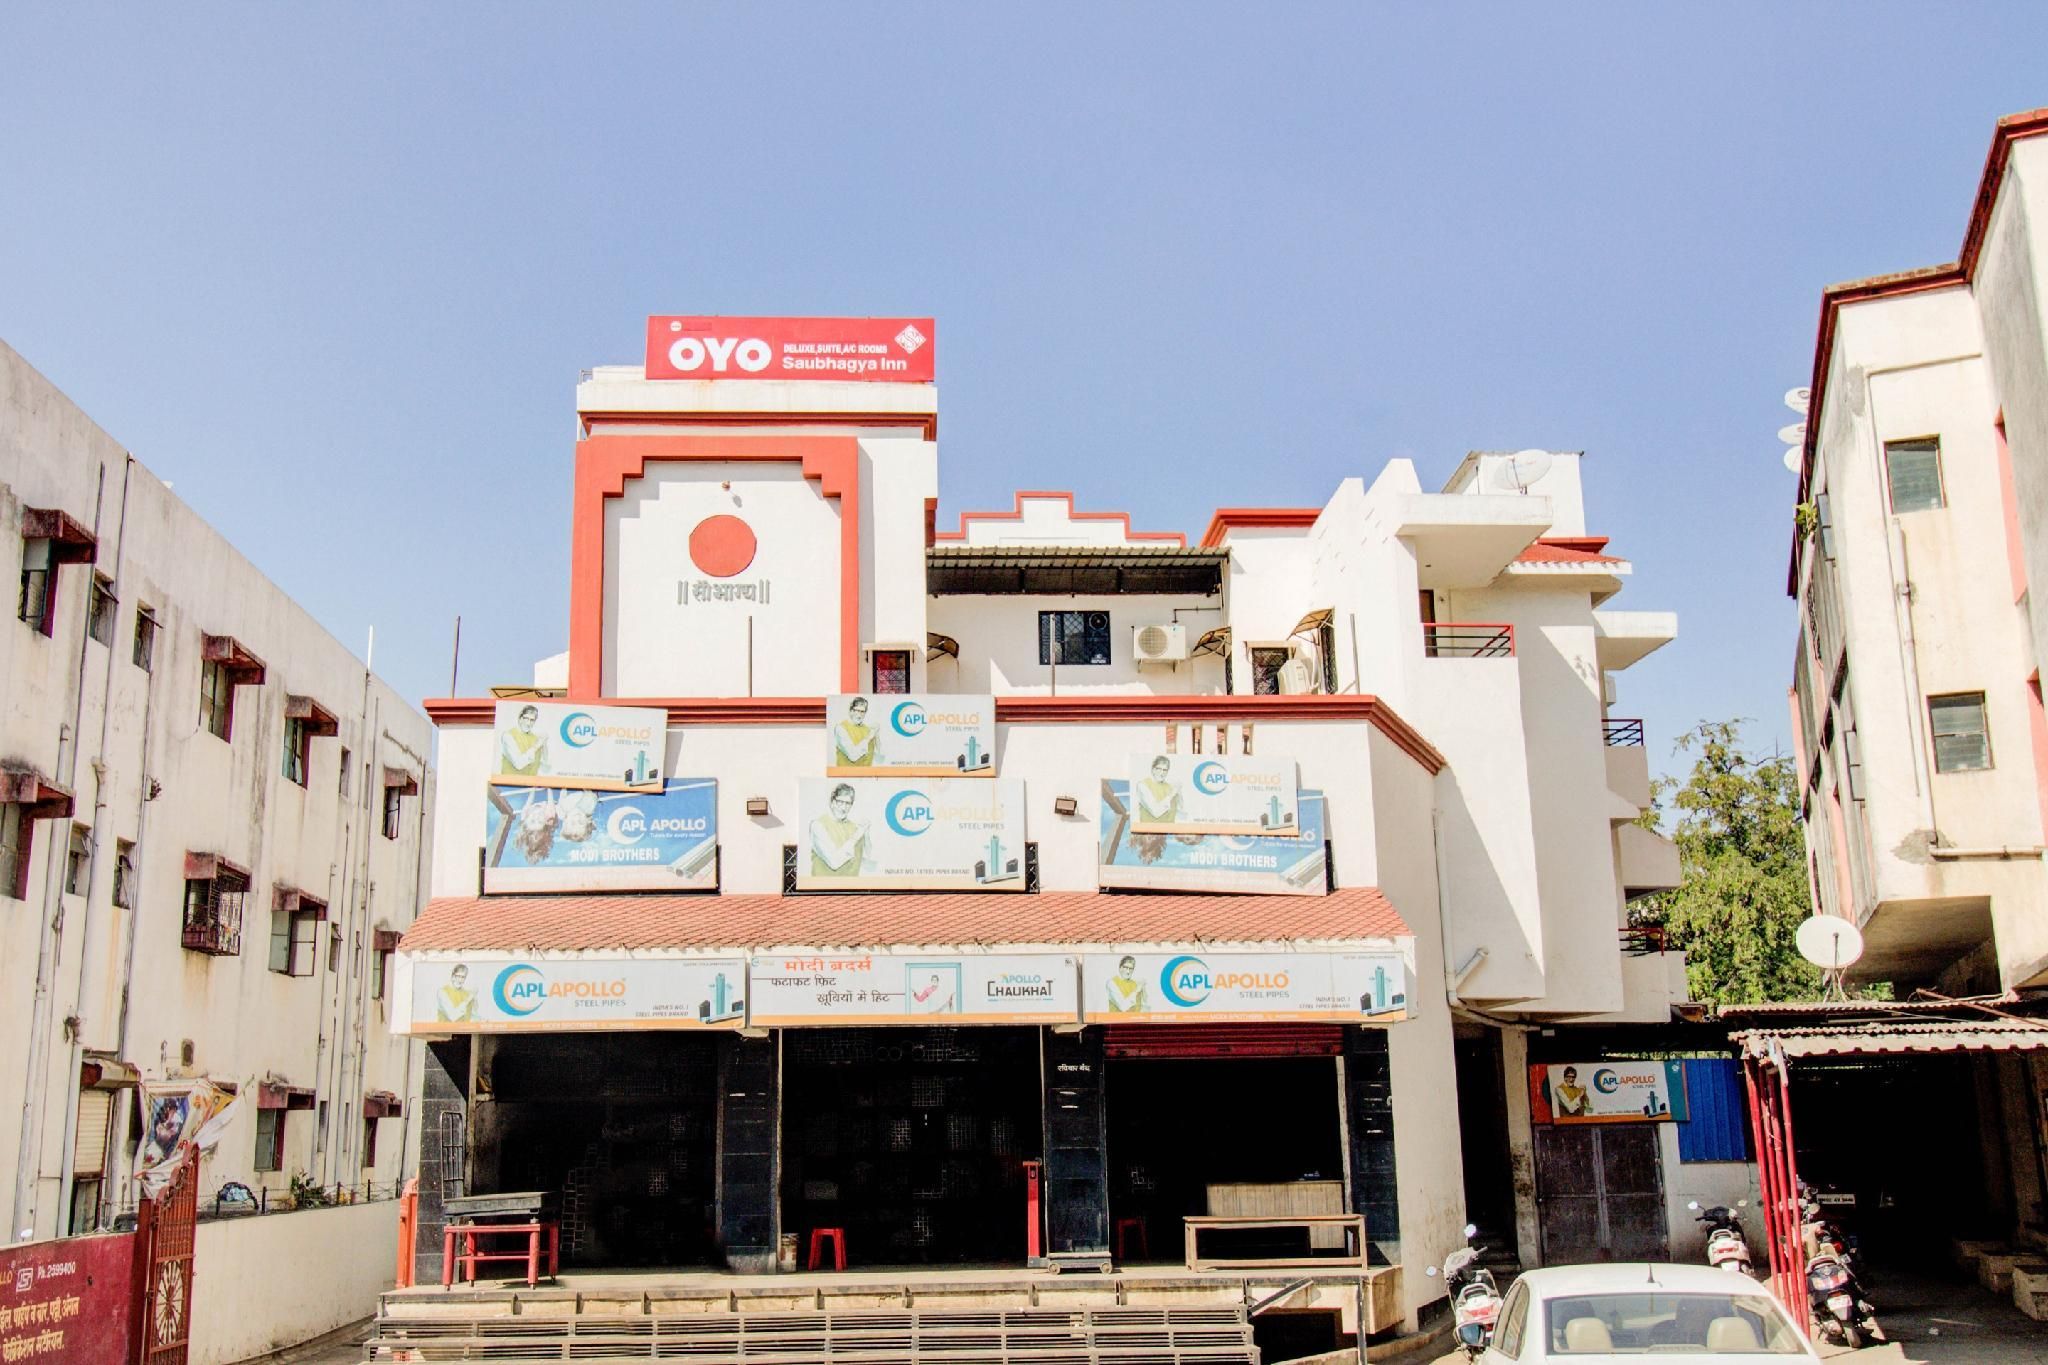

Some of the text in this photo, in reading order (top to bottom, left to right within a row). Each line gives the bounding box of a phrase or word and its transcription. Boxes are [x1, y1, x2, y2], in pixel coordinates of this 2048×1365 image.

[668, 337, 773, 372] OYO
[858, 344, 888, 355] ROOMS
[782, 356, 908, 374] Saubhagya Inn
[903, 713, 980, 725] APL APOLLO
[572, 724, 651, 740] APL APOLLO
[1205, 774, 1281, 785] APL APOLLO
[902, 806, 1003, 821] APL APOLLO
[621, 818, 706, 832] APL APOLLO
[958, 822, 1005, 830] STEEL PIPES
[602, 847, 660, 861] BROTHERS
[1189, 852, 1278, 868] MODI BROTHERS
[784, 957, 824, 972] मोदी
[771, 977, 811, 987] फटाफट
[1001, 973, 1041, 984] APOLLO
[1178, 973, 1289, 989] APL APOLLO
[512, 981, 626, 998] APL APOLLO
[987, 980, 1054, 997] CHAUKHAT
[574, 998, 626, 1007] STEEL PIPES
[871, 989, 890, 1003] हिट
[1602, 1075, 1656, 1086] APL APOLLO
